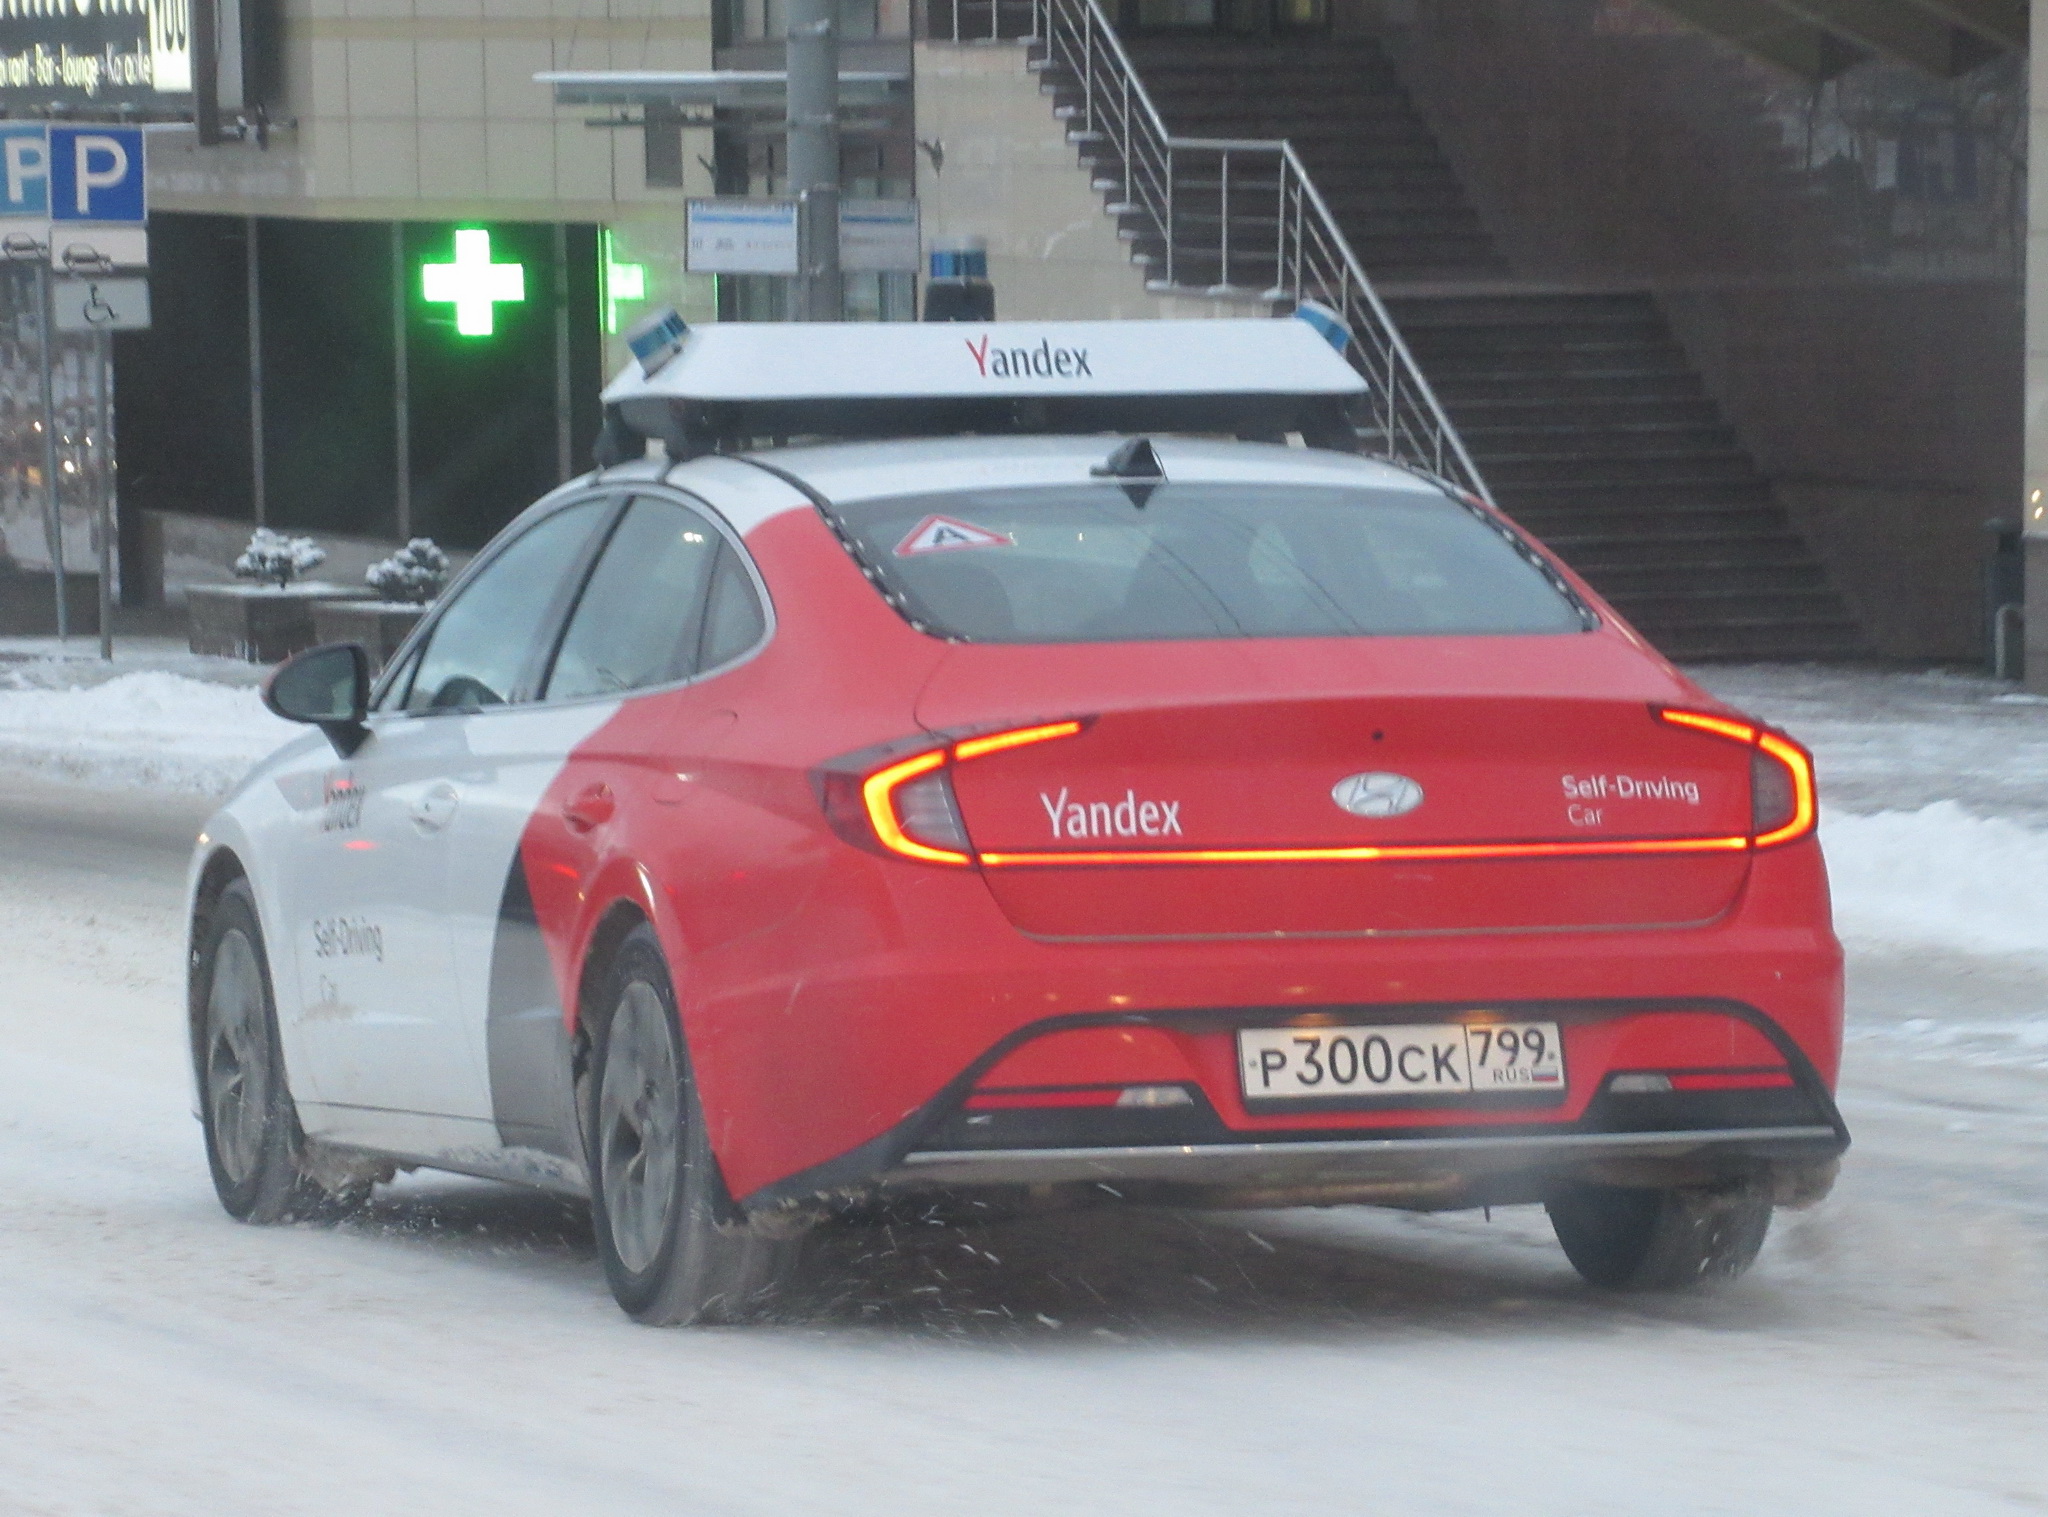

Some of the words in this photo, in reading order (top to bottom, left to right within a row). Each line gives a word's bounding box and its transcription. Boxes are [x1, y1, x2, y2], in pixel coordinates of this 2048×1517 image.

[5, 136, 49, 204] P
[75, 135, 127, 214] P
[965, 333, 1092, 378] Yandex
[1562, 775, 1699, 804] Self-Driving
[1040, 786, 1182, 838] Yandex
[1568, 804, 1602, 826] Car
[1469, 1027, 1546, 1067] 799
[1493, 1068, 1531, 1084] RUS
